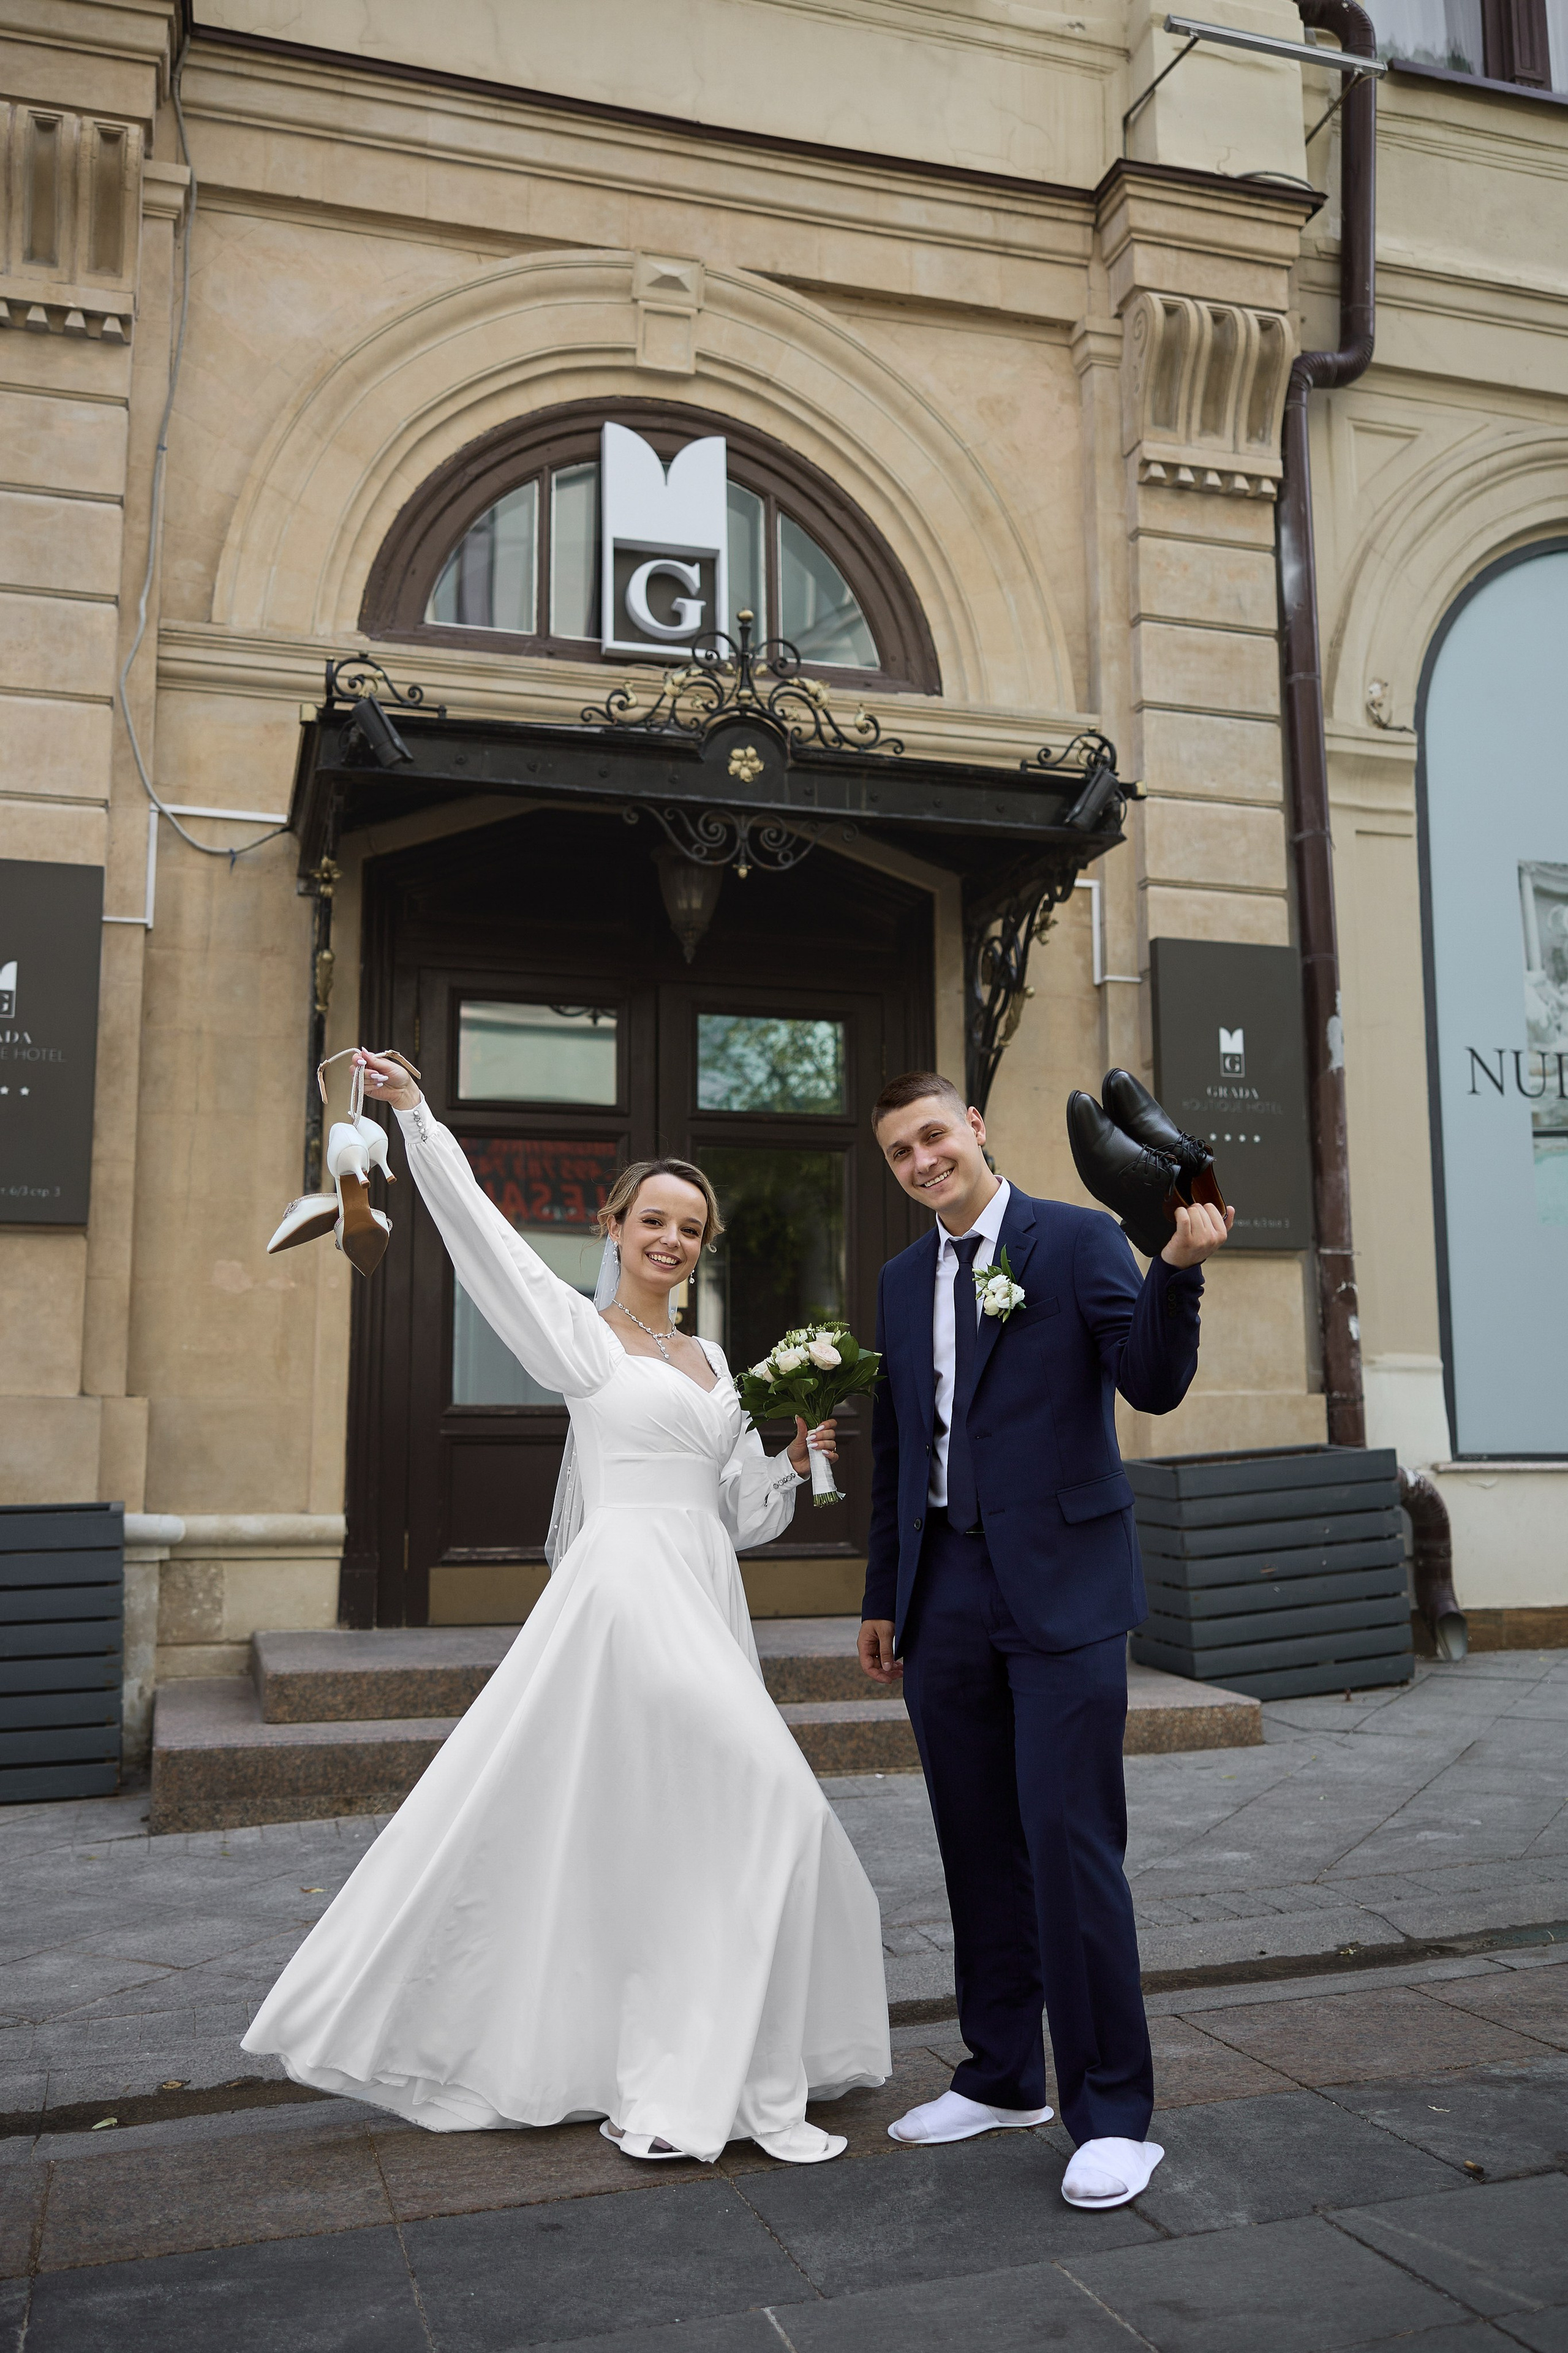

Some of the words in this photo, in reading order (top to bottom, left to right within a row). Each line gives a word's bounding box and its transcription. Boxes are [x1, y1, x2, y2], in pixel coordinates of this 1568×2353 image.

[625, 559, 706, 640] G
[13, 1047, 67, 1063] HOTEL
[1225, 1055, 1240, 1073] G
[1207, 1085, 1259, 1100] GRADA
[1246, 1100, 1284, 1115] HOTEL
